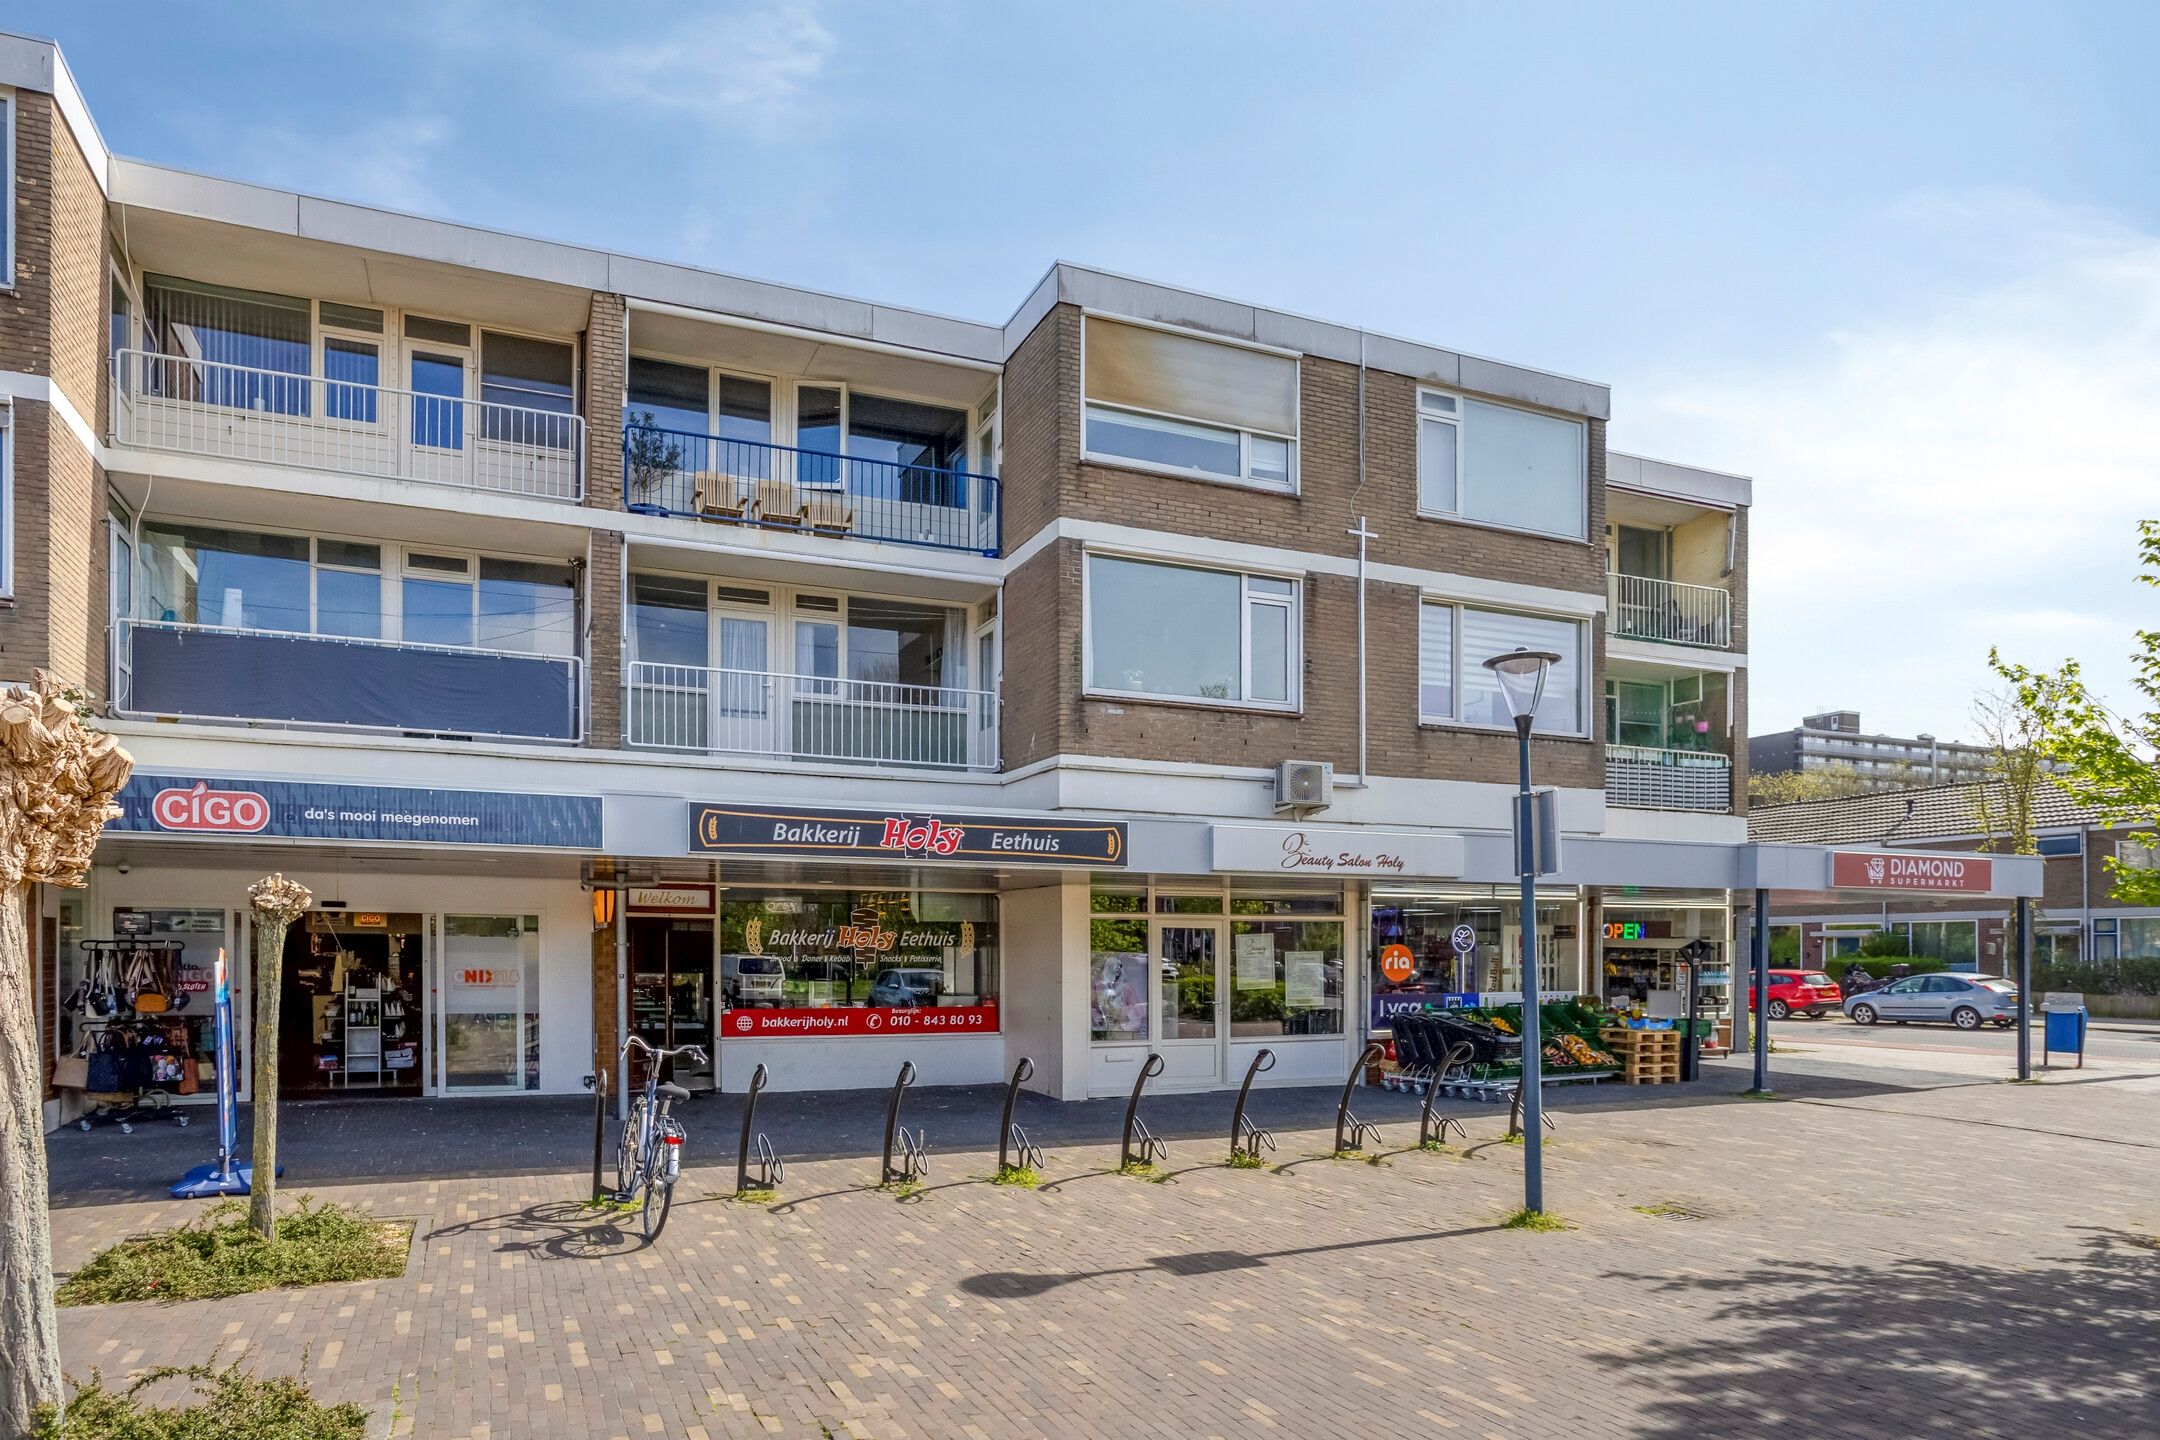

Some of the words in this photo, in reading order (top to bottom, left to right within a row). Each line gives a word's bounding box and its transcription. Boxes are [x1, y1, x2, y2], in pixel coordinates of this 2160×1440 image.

[161, 783, 263, 826] CIGO
[304, 807, 335, 820] da's
[339, 810, 376, 822] mooi
[381, 811, 479, 826] meegenomen
[772, 822, 861, 847] Bakkerij
[881, 817, 965, 856] Holy
[991, 831, 1060, 852] Eethuis
[1280, 832, 1335, 871] Beauty
[1336, 852, 1373, 868] Salon
[1375, 854, 1405, 872] Holy
[1890, 858, 1965, 878] DIAMOND
[1889, 877, 1965, 887] SUPERMARKT
[637, 891, 700, 906] Welkom
[768, 928, 836, 949] Bakkerij
[836, 925, 898, 951] Holy
[899, 930, 956, 947] Eethuis
[1602, 922, 1645, 940] OPEN
[828, 954, 851, 962] Kebab
[880, 954, 902, 963] Snacks
[1385, 950, 1410, 970] ria
[1489, 957, 1500, 975] Bull
[761, 1015, 849, 1030] bakkerijholy.nl
[889, 1015, 911, 1026] 010
[923, 1015, 946, 1026] 843
[949, 1015, 965, 1025] 80
[968, 1014, 983, 1025] 93
